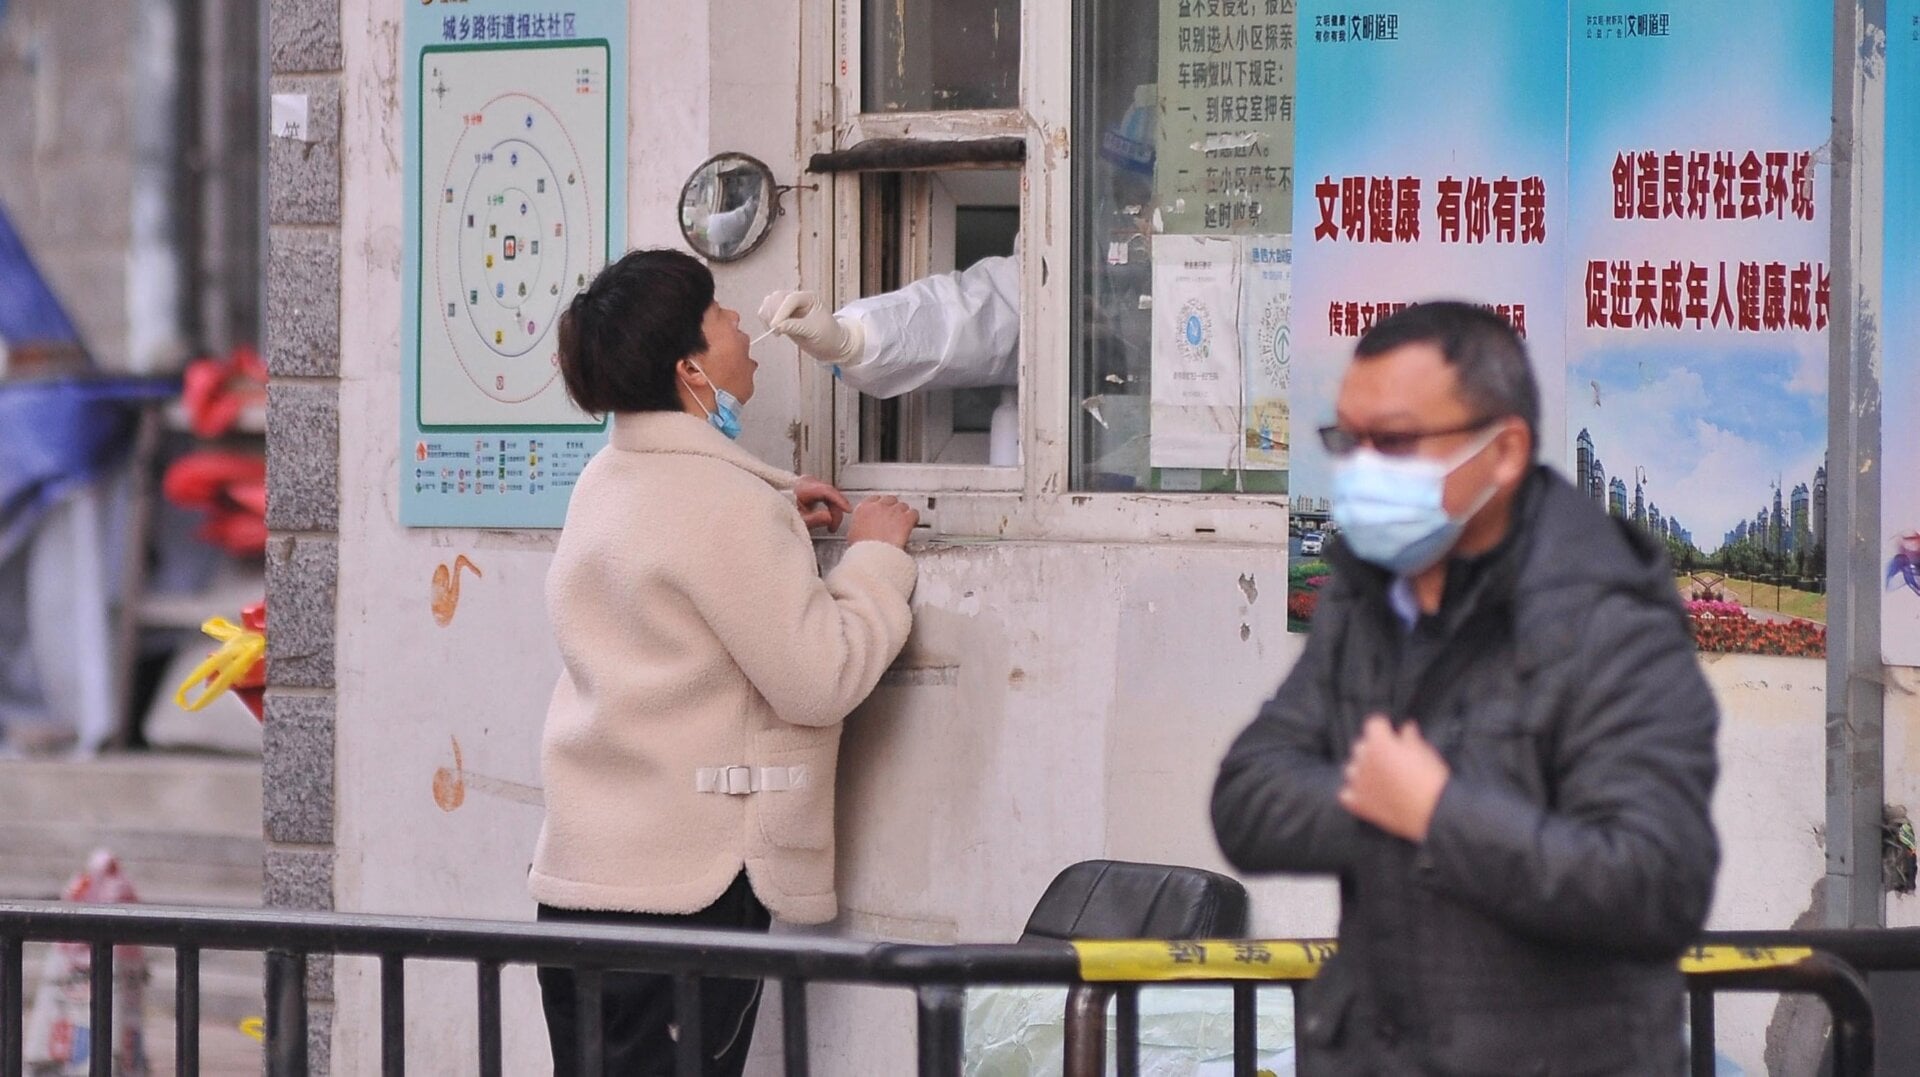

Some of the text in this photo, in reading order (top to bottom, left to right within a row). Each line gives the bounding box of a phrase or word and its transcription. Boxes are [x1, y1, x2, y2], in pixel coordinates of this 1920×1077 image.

[1178, 0, 1296, 18] 益不受侵犯，报达
[443, 12, 576, 41] 城乡路街道报达社区
[1315, 13, 1398, 41] 文明健康 文明道里
[1315, 30, 1346, 42] 有你有我
[1586, 29, 1623, 39] 公益广告
[1626, 13, 1670, 37] 文明道里
[1178, 95, 1296, 123] 一、到保安室押有
[1612, 150, 1815, 221] 创造良好社会环境
[1314, 175, 1546, 245] 文明健康 有你有我
[1584, 260, 1830, 332] 促进未成年人健康成长
